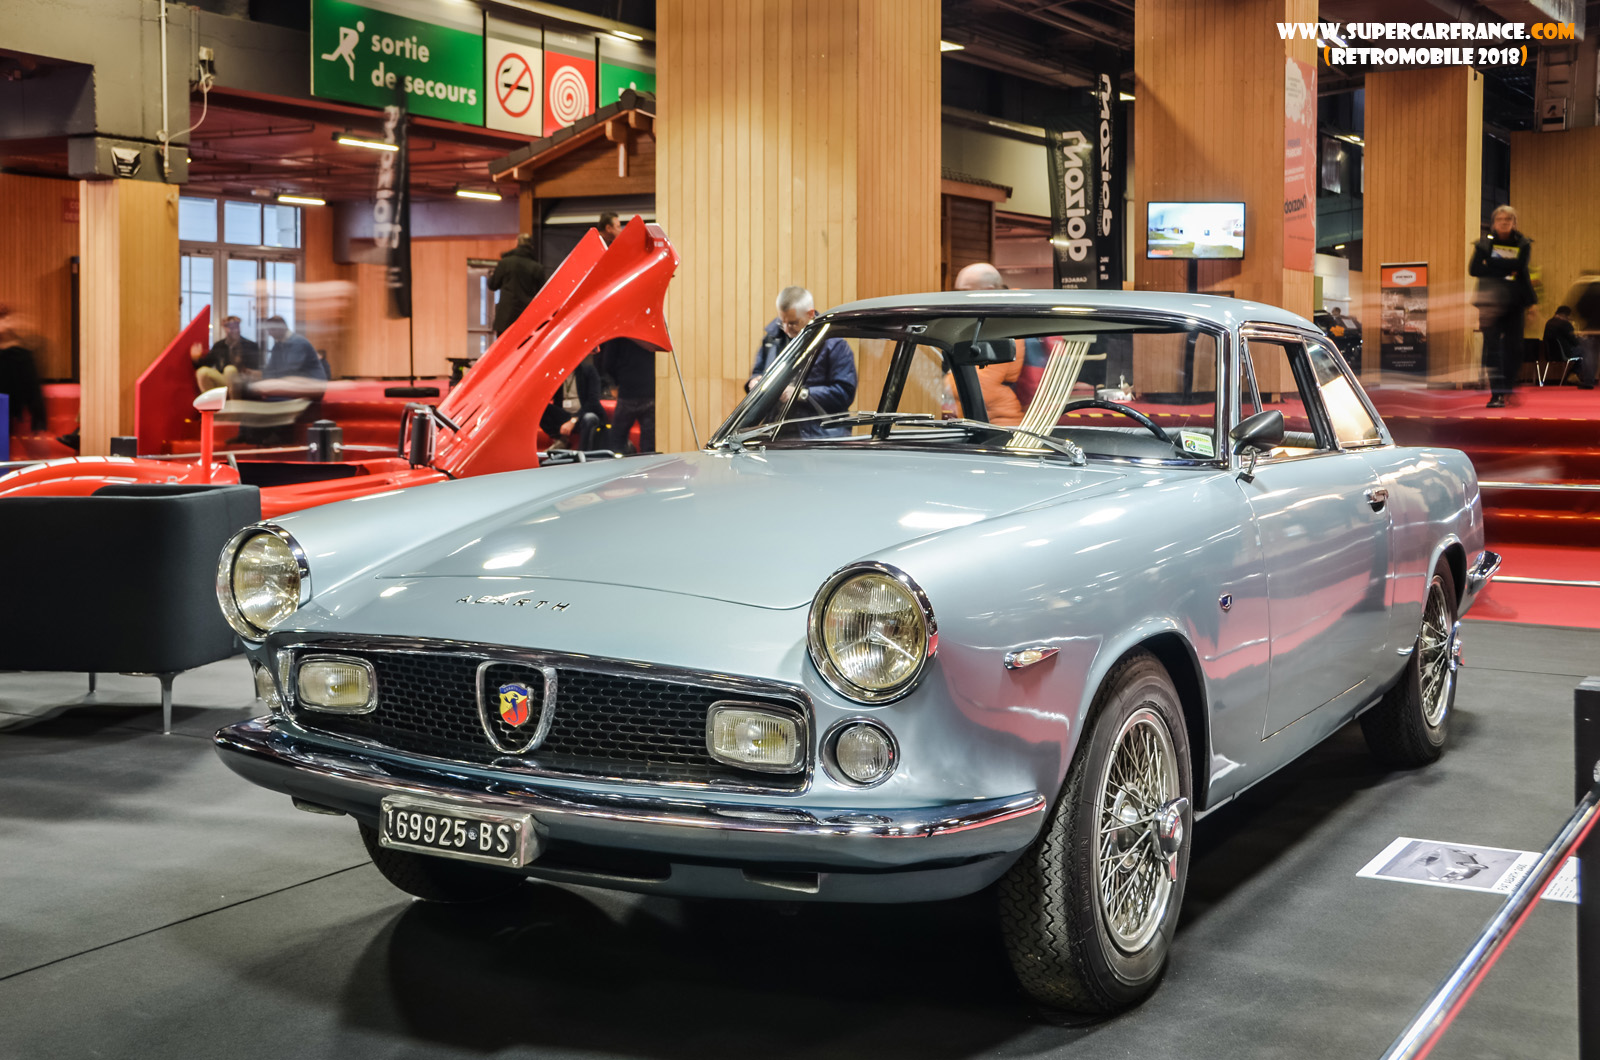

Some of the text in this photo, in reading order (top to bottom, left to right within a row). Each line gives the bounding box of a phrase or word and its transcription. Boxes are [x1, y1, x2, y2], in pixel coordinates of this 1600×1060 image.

[371, 34, 430, 63] sortie
[371, 61, 478, 106] de secours
[456, 594, 571, 613] ABARTH
[479, 822, 510, 853] BS
